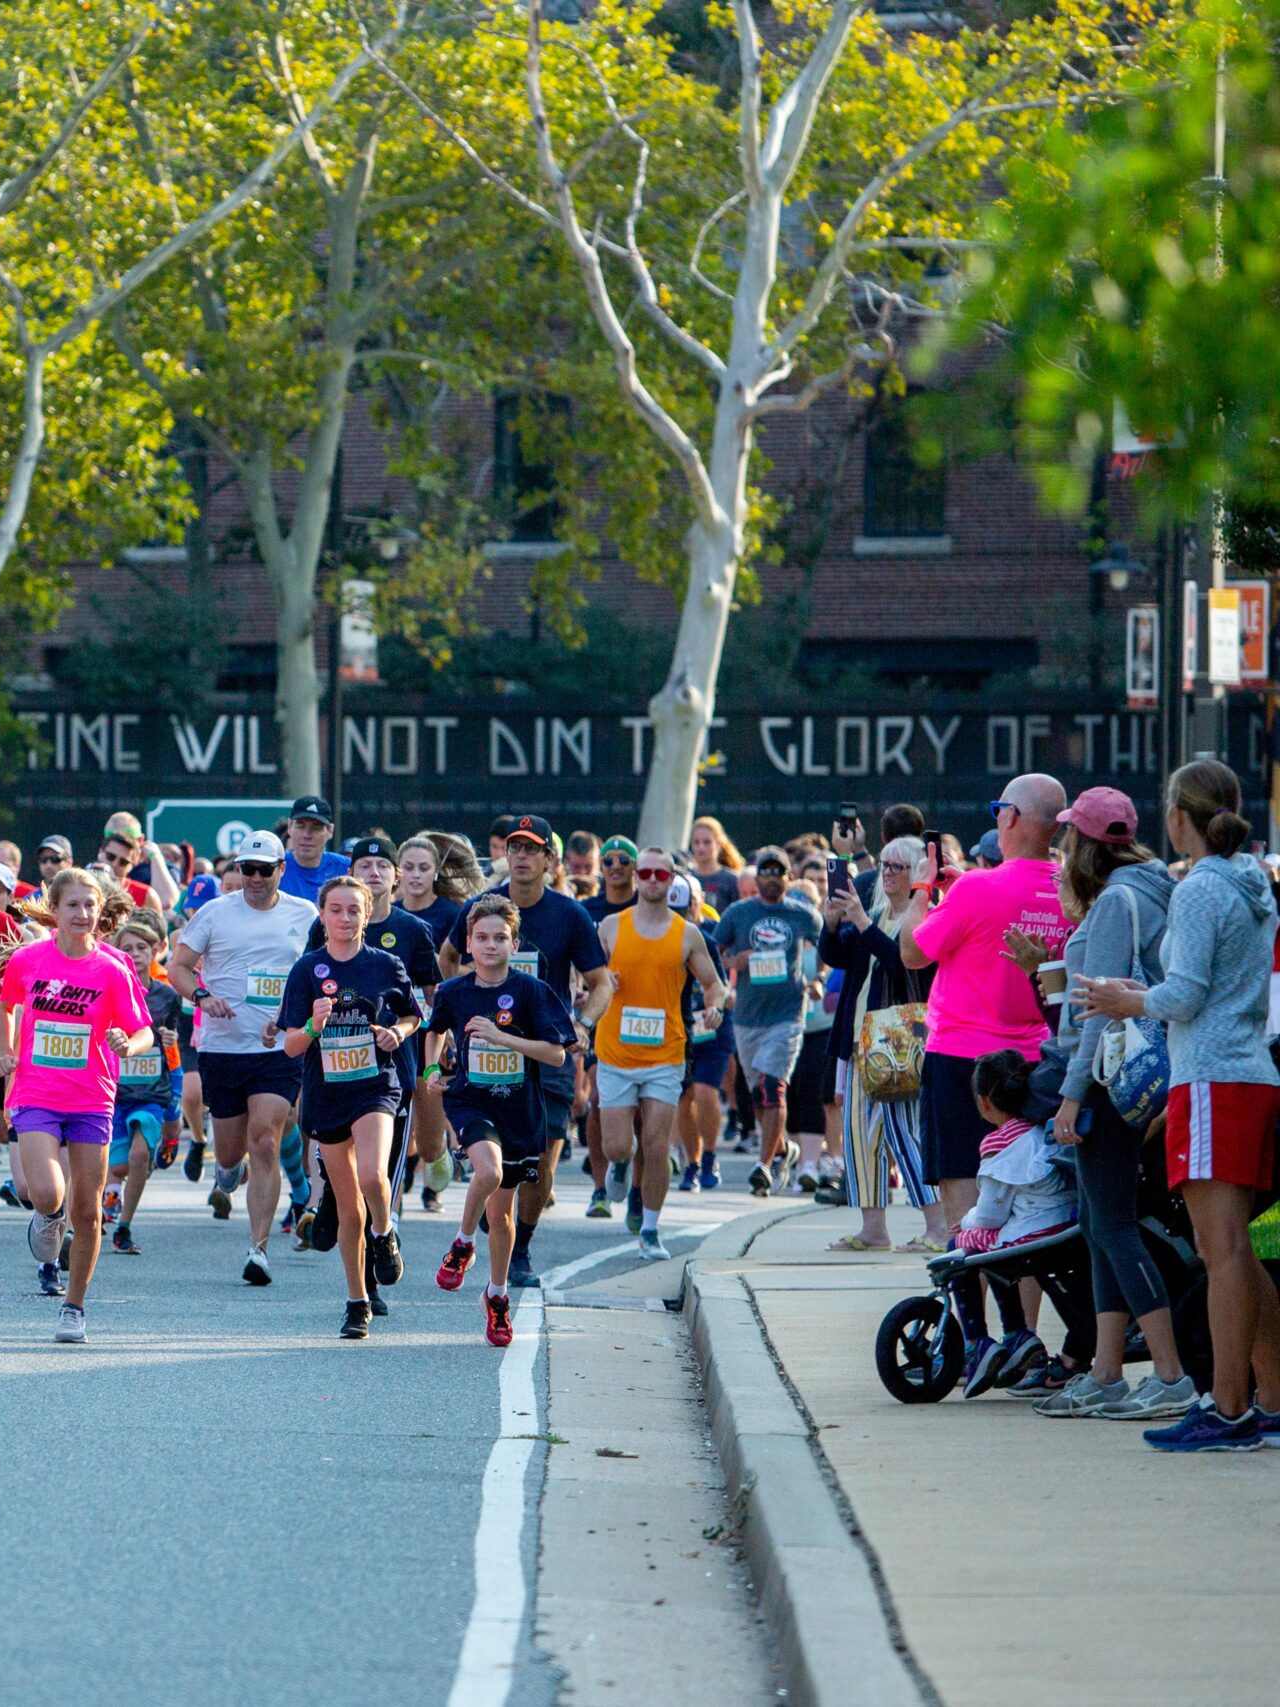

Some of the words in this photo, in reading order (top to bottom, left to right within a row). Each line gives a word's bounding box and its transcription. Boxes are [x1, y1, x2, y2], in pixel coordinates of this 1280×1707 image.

[17, 713, 140, 772] TIME
[169, 714, 278, 774] WIL
[342, 716, 459, 775] NOT
[488, 716, 592, 776] DIM
[621, 716, 728, 775] TE
[758, 715, 963, 776] GLORY
[987, 715, 1051, 773] OF
[254, 977, 287, 997] 198
[31, 996, 90, 1017] MILERS
[625, 1018, 660, 1037] 1437
[41, 1034, 84, 1058] 1803
[122, 1056, 157, 1075] 1785
[328, 1047, 371, 1072] 1602
[476, 1051, 519, 1073] 1603
